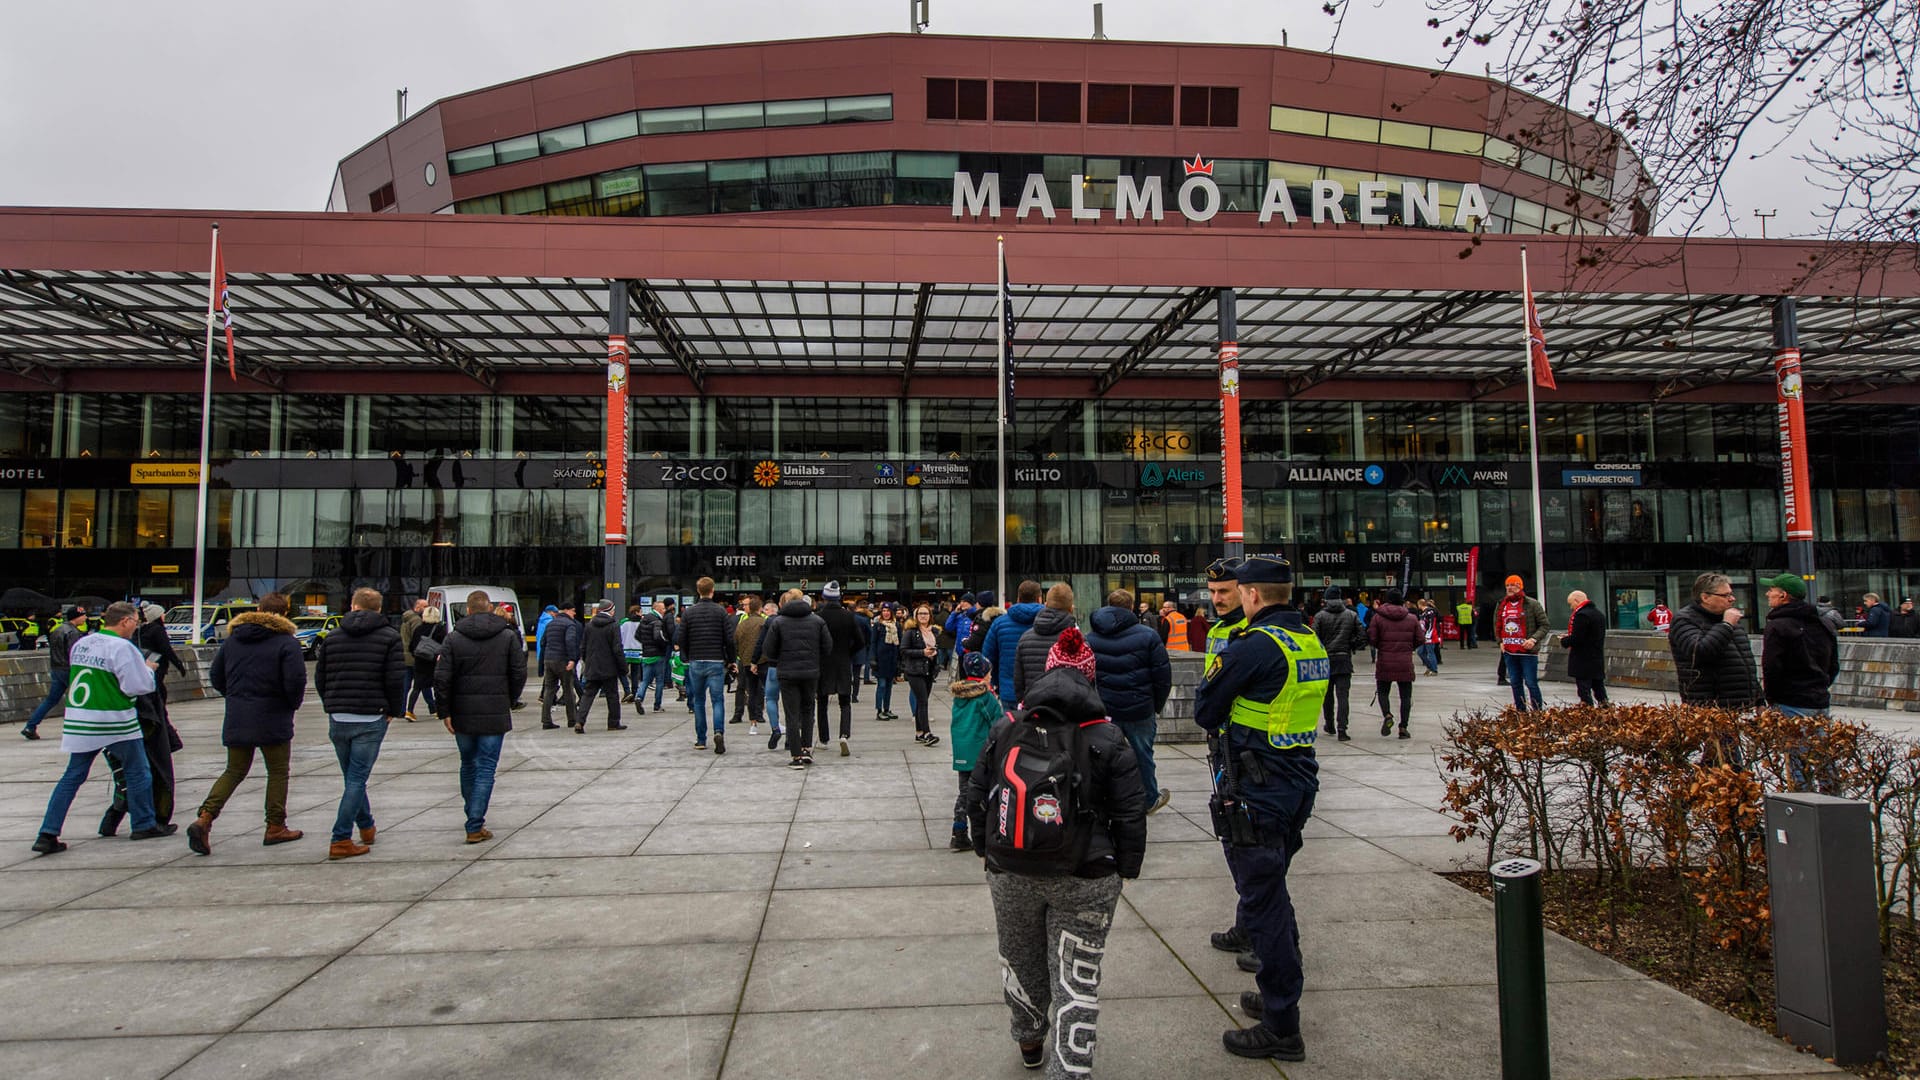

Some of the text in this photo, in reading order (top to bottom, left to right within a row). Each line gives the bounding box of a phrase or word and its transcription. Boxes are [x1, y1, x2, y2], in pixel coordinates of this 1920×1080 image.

[1258, 179, 1494, 227] ARENA
[136, 468, 186, 480] Sparbanken
[783, 465, 825, 475] Unilabs
[922, 464, 969, 474] Myresjöhus
[1167, 468, 1205, 481] Aleris
[1288, 468, 1363, 482] ALLIANCE
[1473, 471, 1508, 480] AVARN
[873, 477, 898, 485] OBOS
[1781, 450, 1796, 525] REDHAWKS
[1111, 554, 1161, 564] KONTOR
[1371, 552, 1402, 563] ENTR
[68, 668, 92, 707] 6
